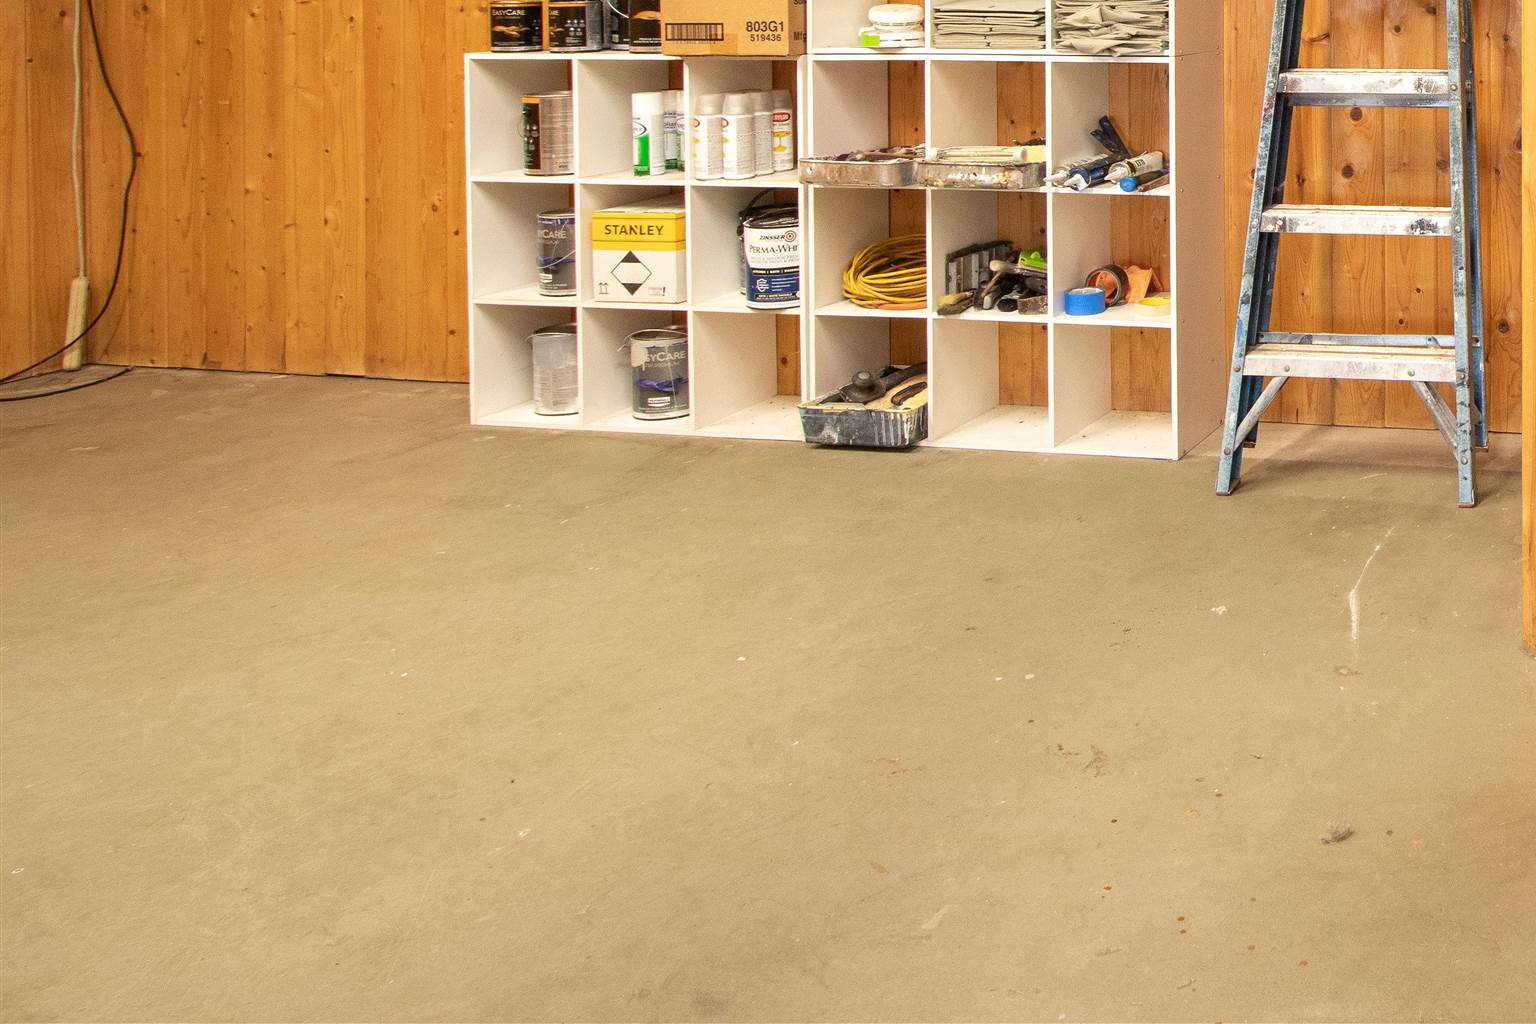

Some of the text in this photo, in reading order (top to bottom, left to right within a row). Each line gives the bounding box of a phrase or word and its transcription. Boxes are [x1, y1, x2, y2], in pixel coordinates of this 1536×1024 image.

[745, 21, 785, 33] 803G1
[750, 34, 782, 42] 519436
[604, 224, 665, 236] STANLEY
[750, 244, 798, 254] PERMA-WHI
[646, 350, 687, 363] SYCARE
